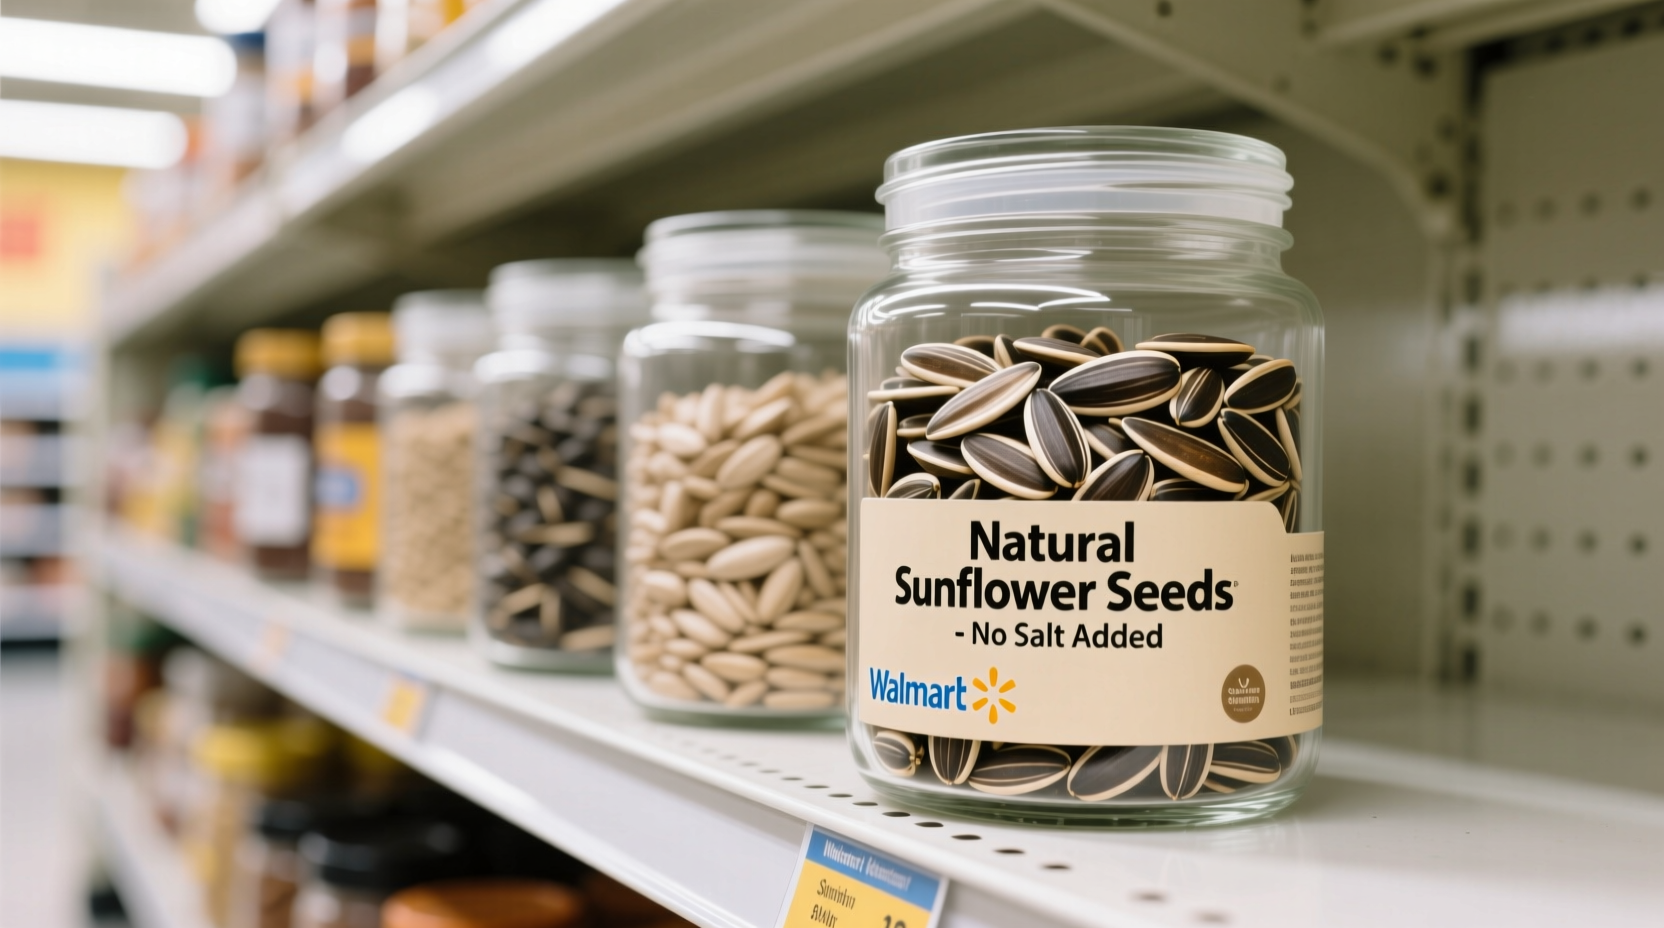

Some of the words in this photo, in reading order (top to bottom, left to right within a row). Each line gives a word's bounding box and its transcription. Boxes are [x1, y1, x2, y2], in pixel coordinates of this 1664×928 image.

[970, 520, 1135, 564] Natural
[895, 565, 1097, 612] Sunflower
[1106, 568, 1234, 613] Seeds
[972, 621, 1007, 647] No
[1014, 621, 1066, 648] Salt
[1071, 622, 1163, 649] Added
[869, 666, 968, 712] Walmart
